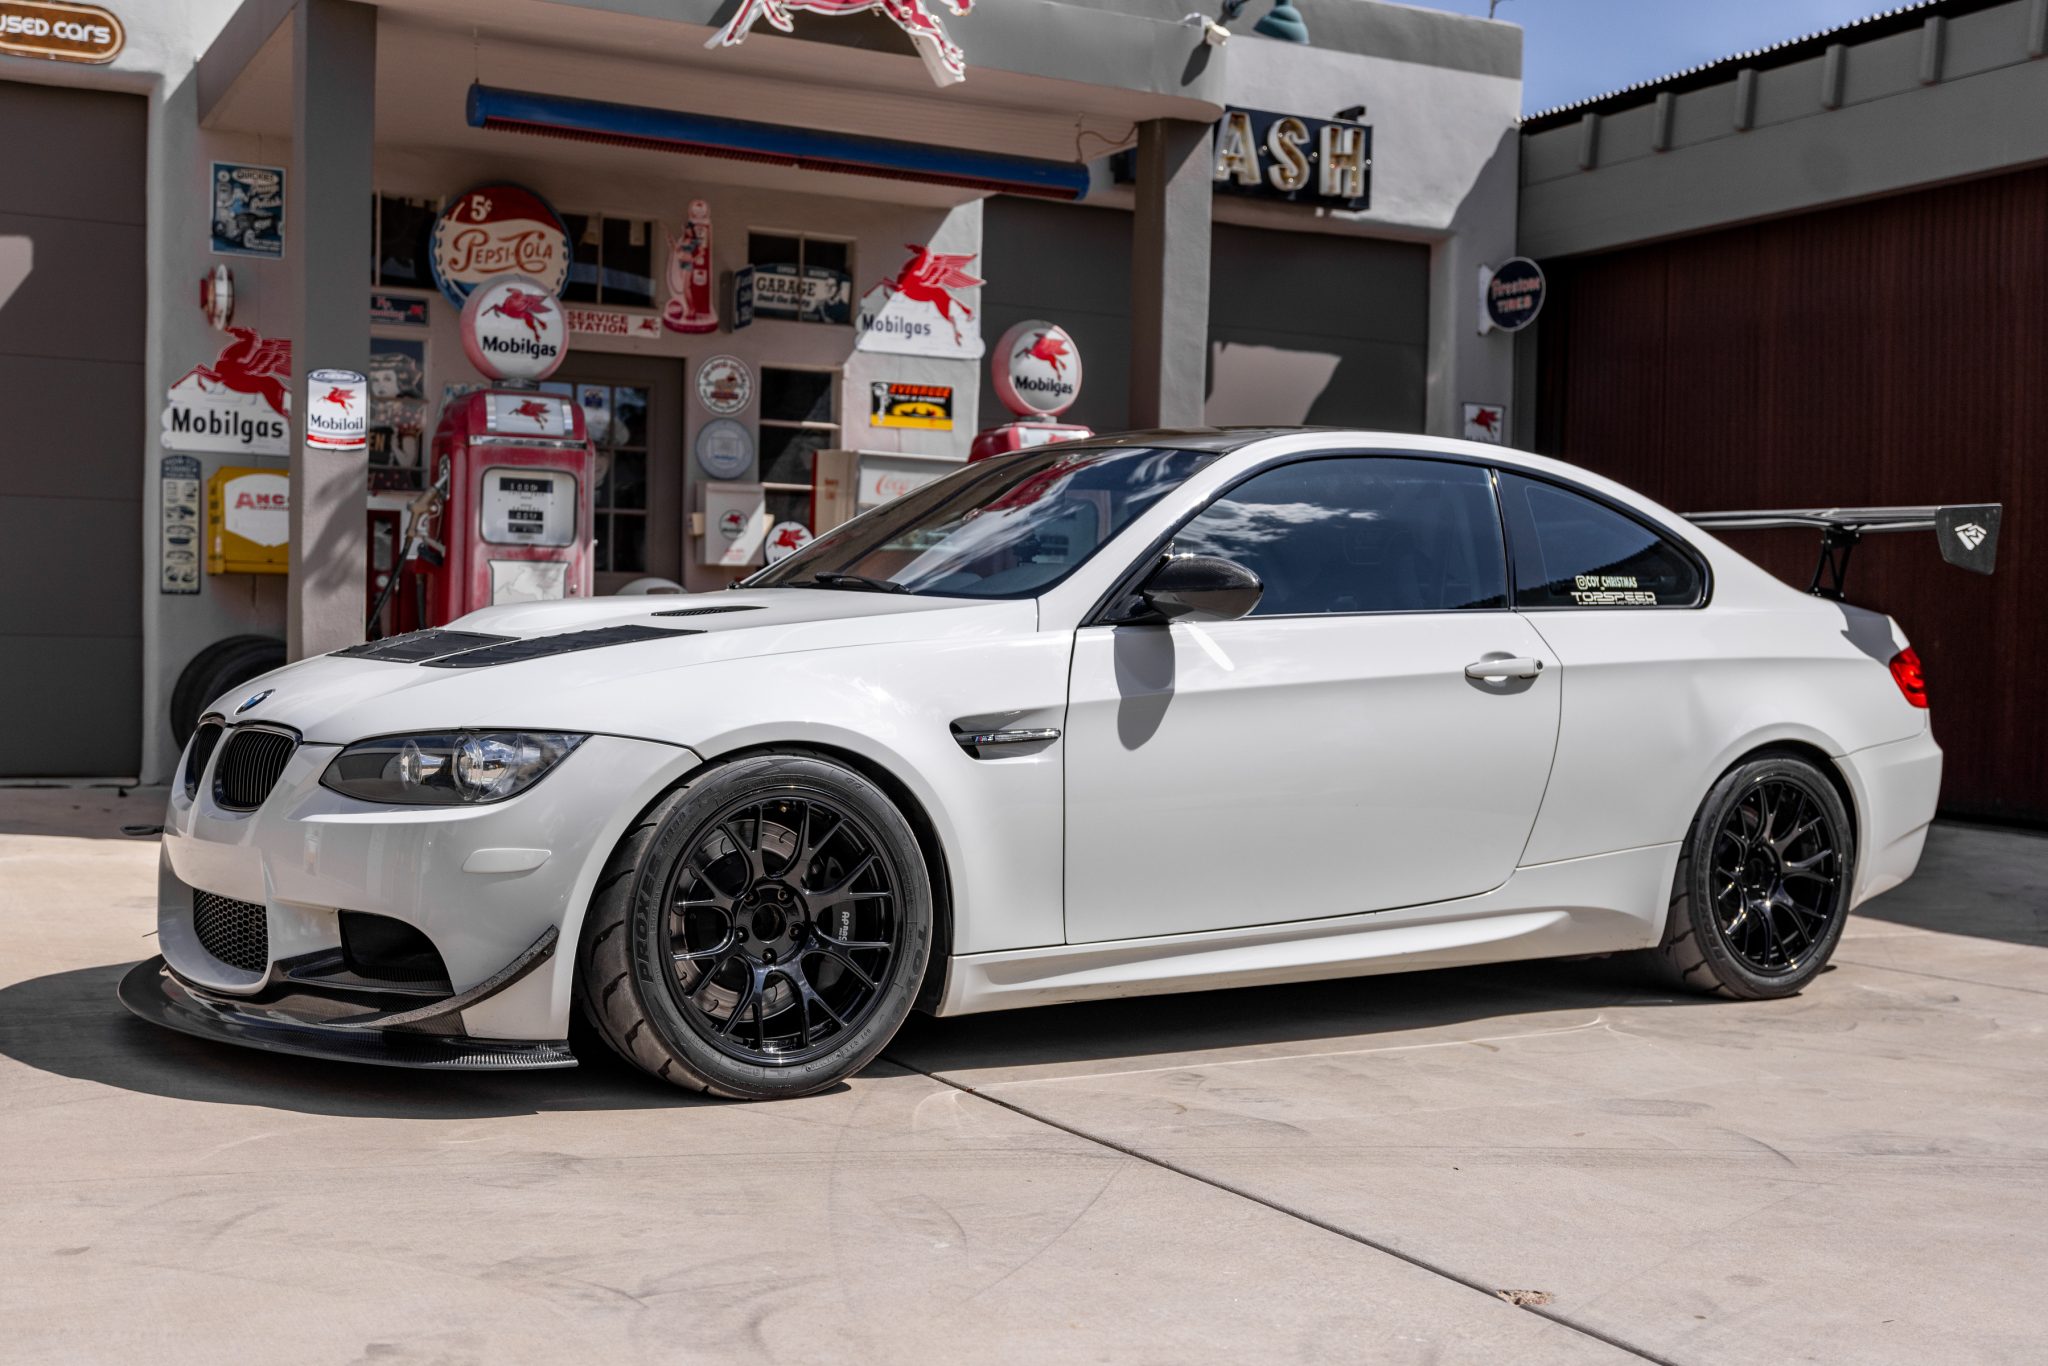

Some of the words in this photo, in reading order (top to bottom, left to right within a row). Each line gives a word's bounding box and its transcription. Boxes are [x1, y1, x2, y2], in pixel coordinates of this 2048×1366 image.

[1213, 111, 1366, 198] ASH
[756, 275, 817, 297] GARAGE
[568, 310, 629, 325] SERVICE
[568, 321, 628, 334] STATION
[862, 313, 932, 340] Mobilgas
[483, 336, 557, 359] Mobilgas
[1015, 374, 1074, 398] Mobilgas
[171, 408, 284, 443] Mobilgas
[310, 414, 363, 430] Mobiloil
[368, 431, 385, 451] EN
[235, 492, 290, 510] ANC
[1570, 591, 1656, 604] TOPSPEED
